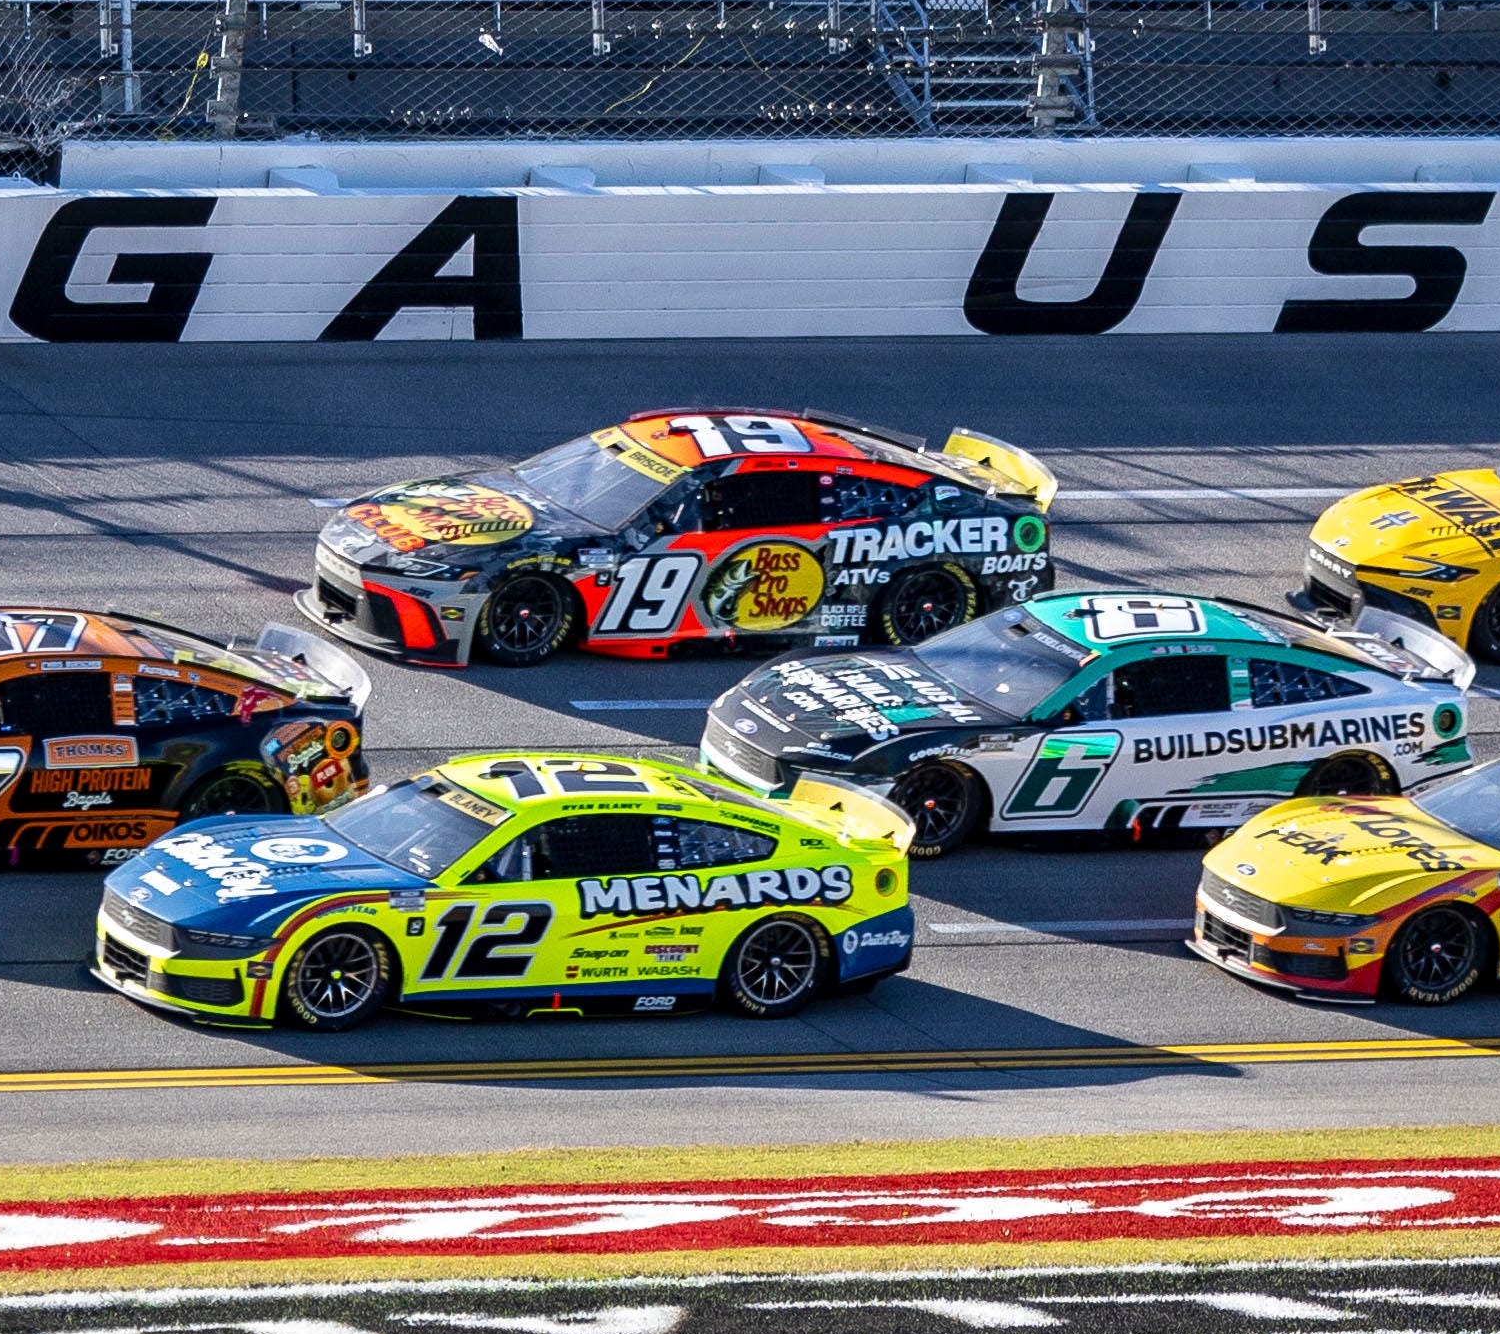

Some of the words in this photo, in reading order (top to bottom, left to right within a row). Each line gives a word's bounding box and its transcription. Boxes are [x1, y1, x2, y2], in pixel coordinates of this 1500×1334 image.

[627, 451, 677, 479] BRISCOE
[346, 503, 426, 553] CLUB
[827, 517, 1009, 564] TRACKER
[755, 548, 800, 572] Bass
[981, 552, 1048, 575] BOATS
[1309, 548, 1352, 579] CAMRY
[753, 572, 788, 593] Pro
[834, 568, 891, 586] ATVs
[599, 555, 700, 633] 19
[749, 593, 808, 620] Shops
[820, 614, 868, 627] COFFEE
[1133, 712, 1426, 765] BUILDSUBMARINES
[1392, 740, 1425, 757] .COM
[30, 771, 74, 794] HIGH
[77, 767, 152, 793] PROTEIN
[1000, 729, 1125, 822] 6
[62, 791, 113, 810] Bagels
[449, 792, 498, 820] BLANEY
[561, 803, 595, 812] RYAN
[597, 802, 643, 811] BLANEY
[73, 821, 148, 841] OIKOS
[800, 838, 824, 847] DEX
[577, 864, 854, 919] MENARDS
[415, 898, 557, 984] 12
[568, 946, 630, 960] Snap-on
[636, 965, 701, 977] WABASH
[633, 996, 677, 1008] FORD
